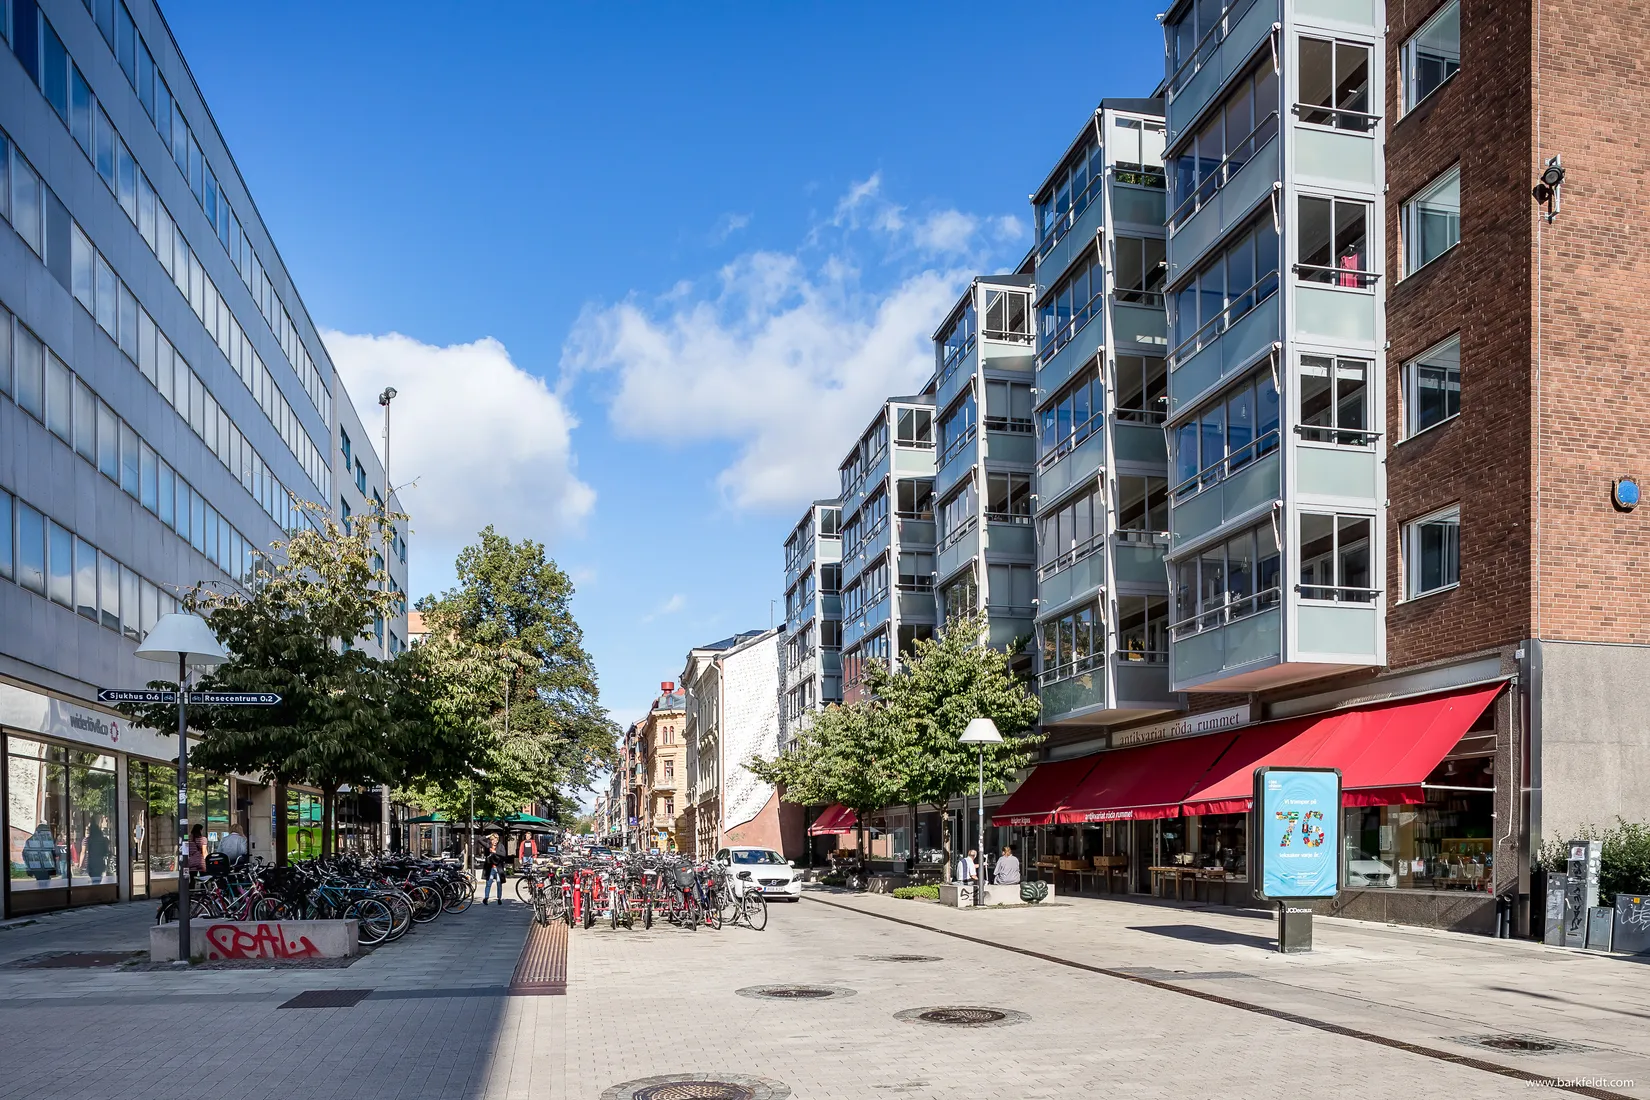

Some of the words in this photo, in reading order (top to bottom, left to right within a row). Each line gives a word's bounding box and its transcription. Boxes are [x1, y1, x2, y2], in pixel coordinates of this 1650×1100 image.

[1119, 728, 1166, 745] antikvariat
[1171, 721, 1192, 737] röda
[1197, 712, 1240, 731] rummet
[1085, 811, 1105, 820] antikvariat
[1106, 810, 1115, 819] röda
[1116, 809, 1133, 818] rummet
[1275, 810, 1324, 848] 76
